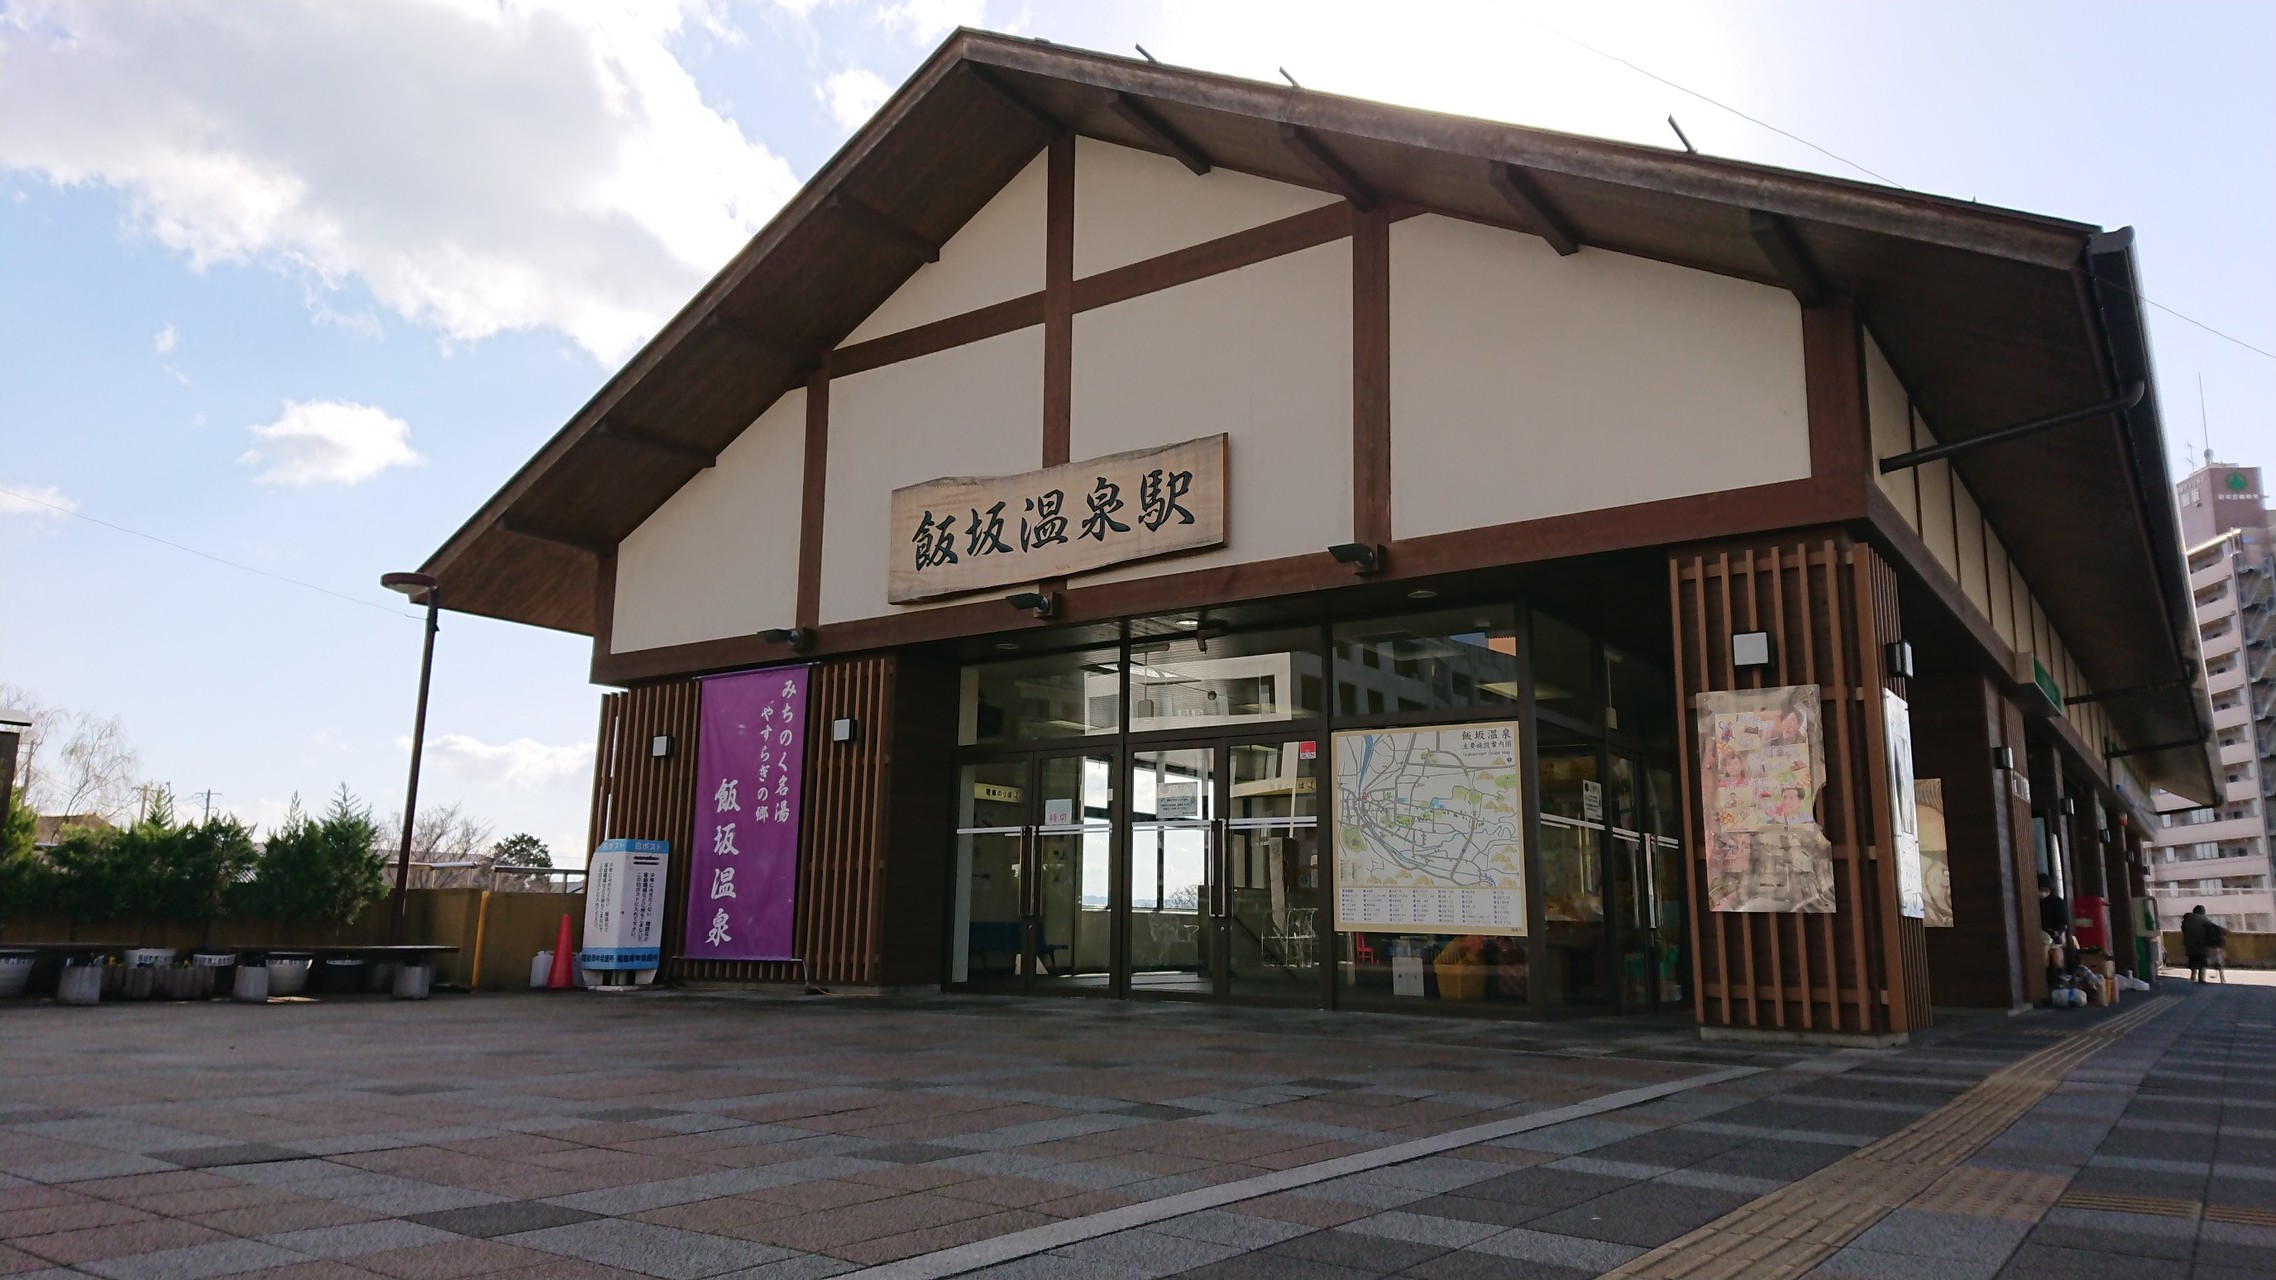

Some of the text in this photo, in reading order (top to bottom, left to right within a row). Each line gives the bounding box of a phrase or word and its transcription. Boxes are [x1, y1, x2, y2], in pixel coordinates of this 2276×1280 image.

[912, 469, 1195, 571] 飯坂温泉駅
[755, 702, 774, 823] やすらぎの郷
[774, 679, 797, 824] みちのく名湯
[1462, 728, 1511, 740] 飯坂温泉
[985, 788, 1012, 798] 電車のりば
[705, 778, 741, 947] 飯坂温泉
